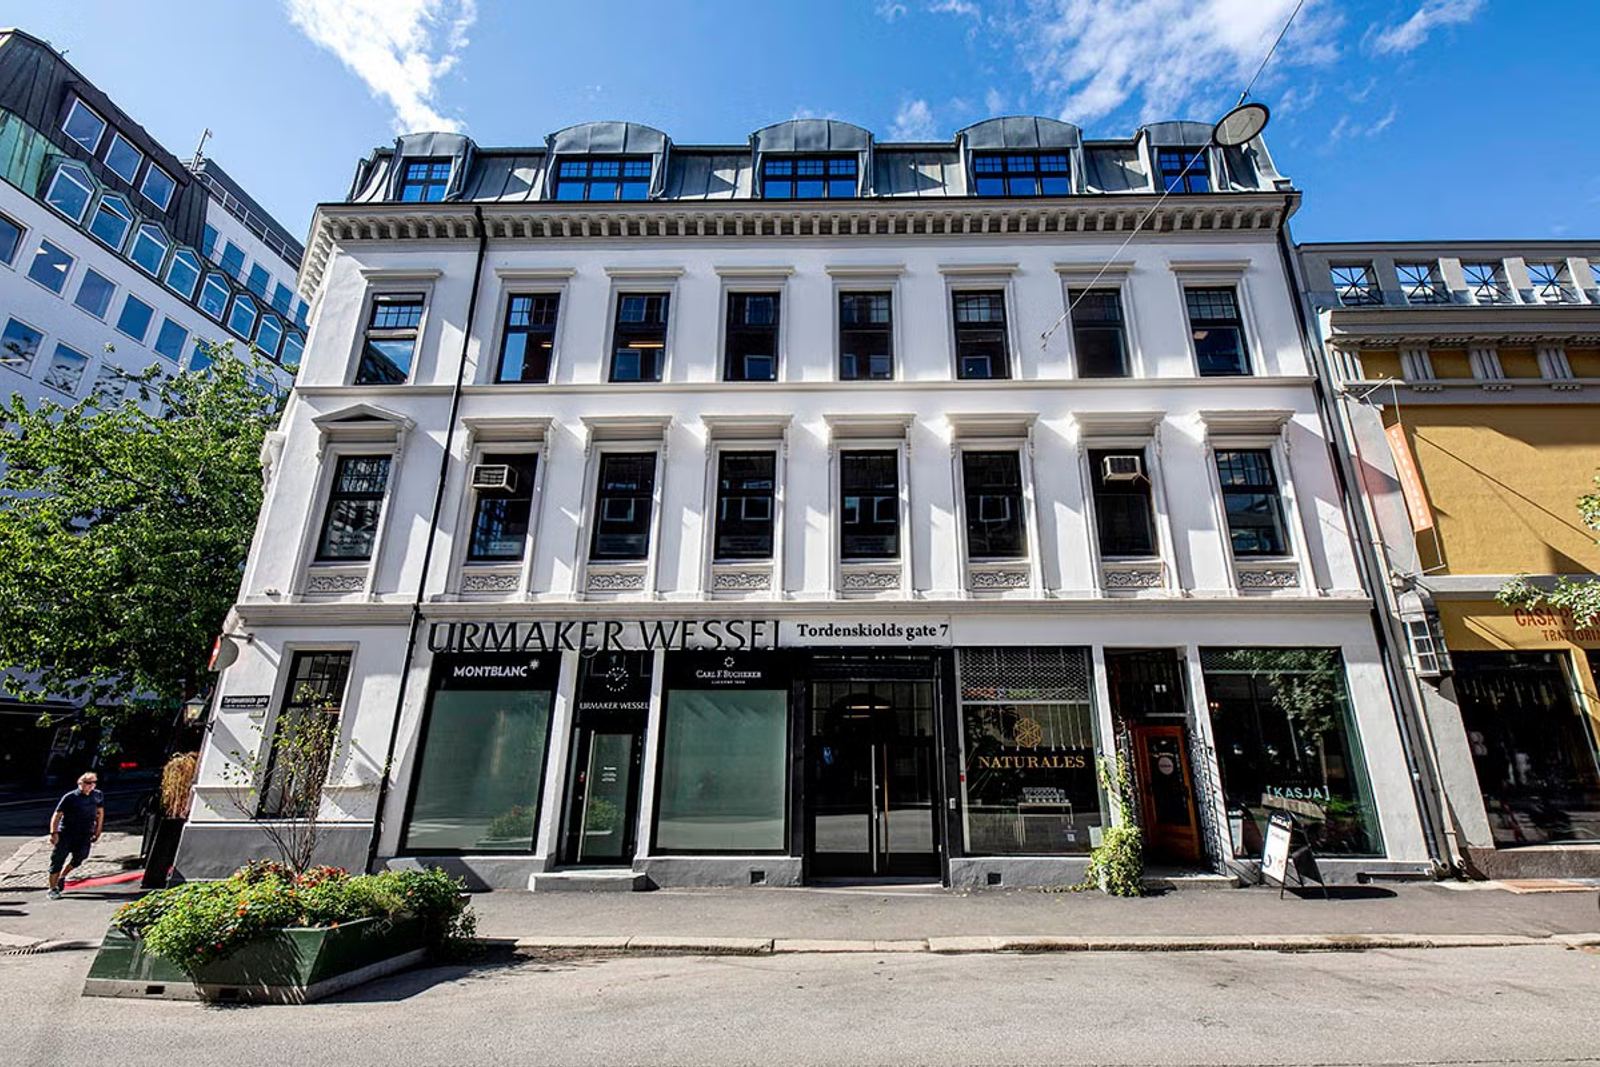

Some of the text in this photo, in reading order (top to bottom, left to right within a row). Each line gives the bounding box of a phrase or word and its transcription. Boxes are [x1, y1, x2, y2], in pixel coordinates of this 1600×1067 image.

[1514, 607, 1558, 627] CASA
[428, 621, 623, 651] URMAKER
[797, 623, 949, 641] Tordenskiolds gate 7
[453, 665, 528, 677] MONTBLANC
[579, 701, 649, 710] URMAKER WESSEL
[978, 755, 1086, 769] NATURALES
